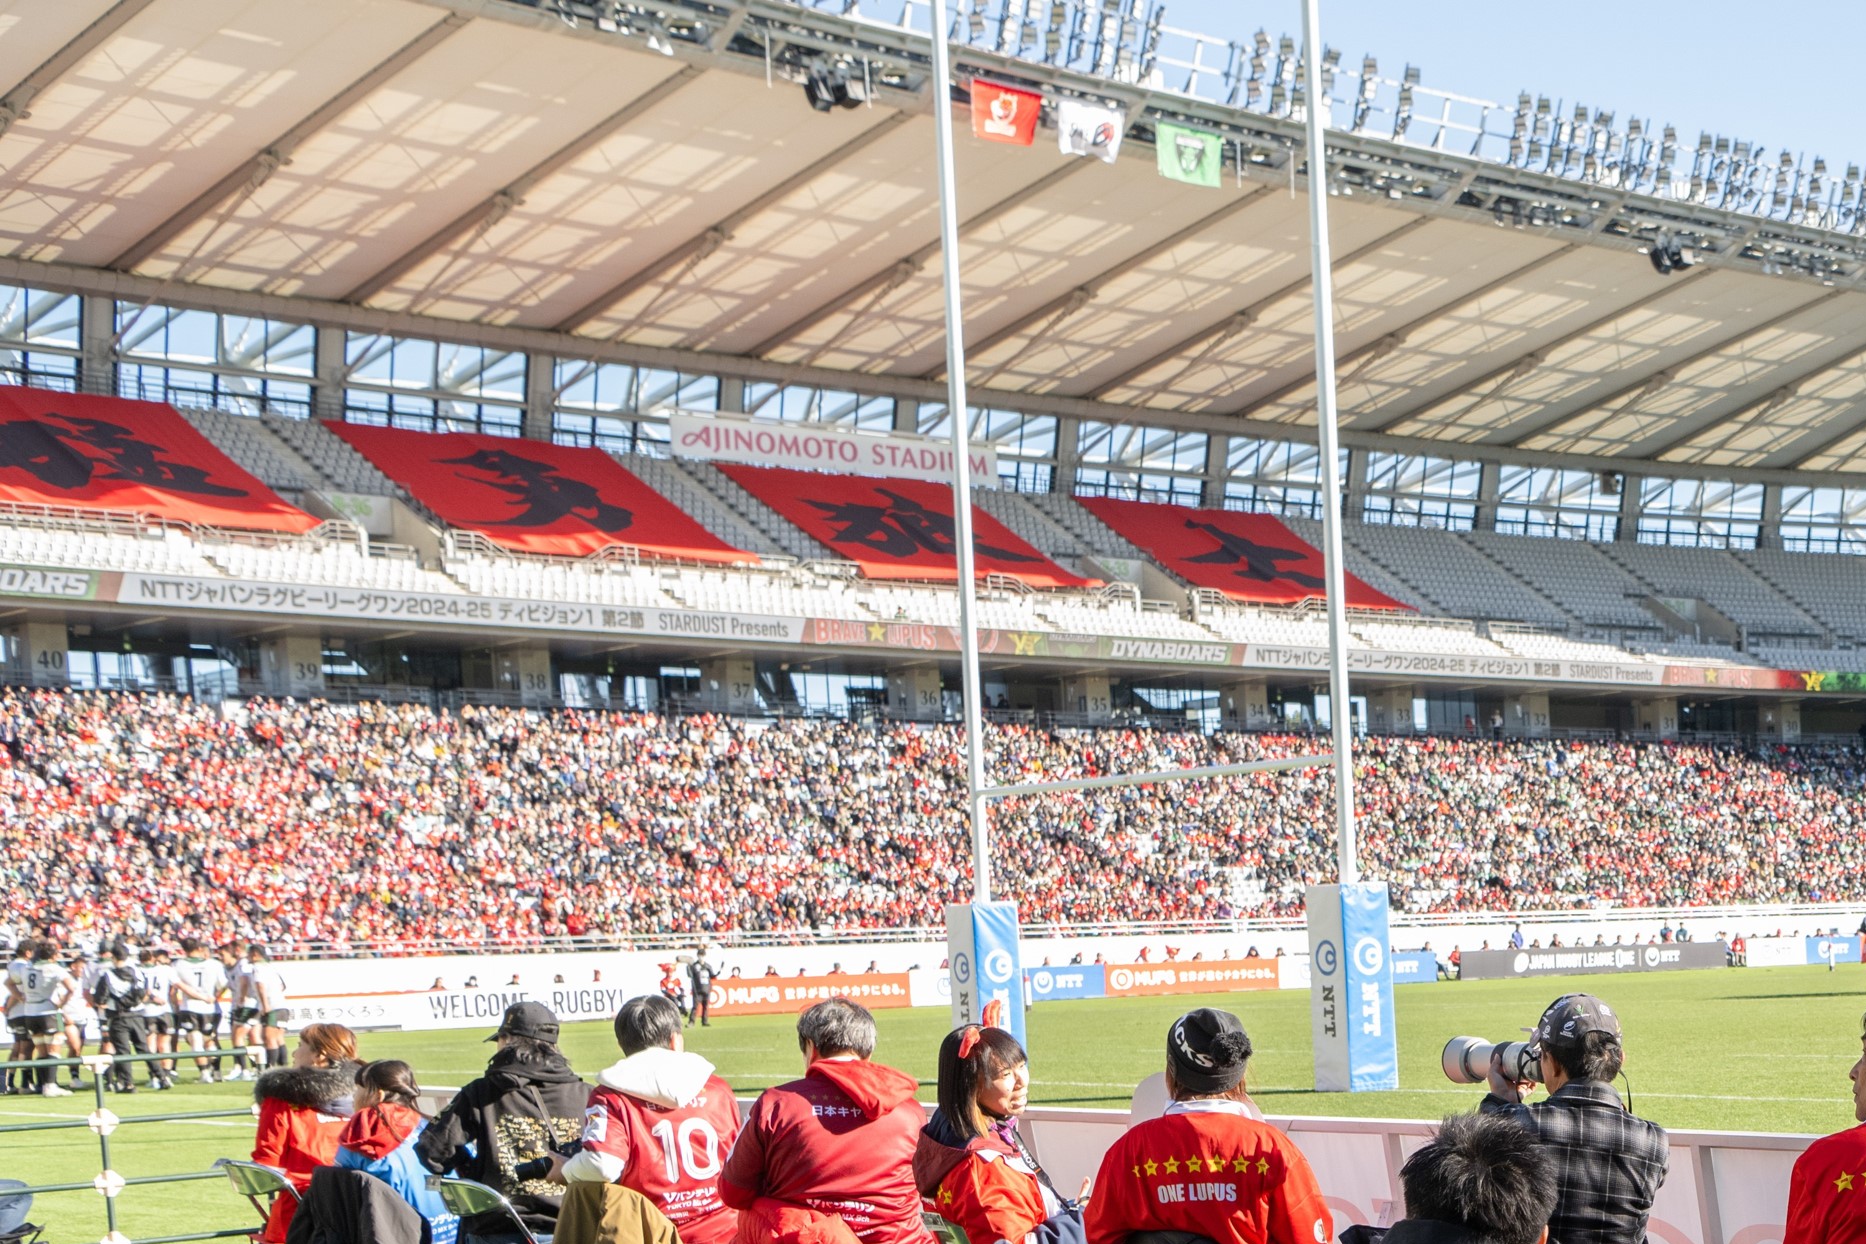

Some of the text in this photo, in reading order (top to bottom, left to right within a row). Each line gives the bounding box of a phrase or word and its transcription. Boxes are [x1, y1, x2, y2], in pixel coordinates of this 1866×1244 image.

[681, 426, 988, 476] AJINOMOTO STADIM
[0, 569, 91, 596] OARS
[659, 612, 727, 635] STARDUST
[731, 617, 789, 639] Presents
[814, 617, 937, 650] BRAVE LUPUS
[37, 650, 63, 669] 40
[1110, 639, 1229, 663] DYNABOARS
[296, 662, 318, 680] 39
[1256, 648, 1466, 672] NTTジャパンラビーリーグワン2024-25
[1569, 663, 1613, 680] STARDUST
[1615, 667, 1653, 682] Presents
[526, 673, 546, 690] 38
[733, 682, 750, 698] 37
[921, 690, 937, 705] 36
[1250, 704, 1264, 717] 34
[1529, 952, 1556, 970] JAPAN
[1556, 951, 1584, 969] RUGBY
[1584, 949, 1614, 967] LEAGUE
[27, 972, 37, 989] 8
[1056, 974, 1084, 989] NTT
[1135, 969, 1177, 987] MUFG
[728, 985, 780, 1004] MUFG
[1322, 985, 1337, 1038] NTT
[1361, 982, 1382, 1037] NTT
[652, 1117, 721, 1184] 10
[1157, 1183, 1237, 1204] ONE LUPUS
